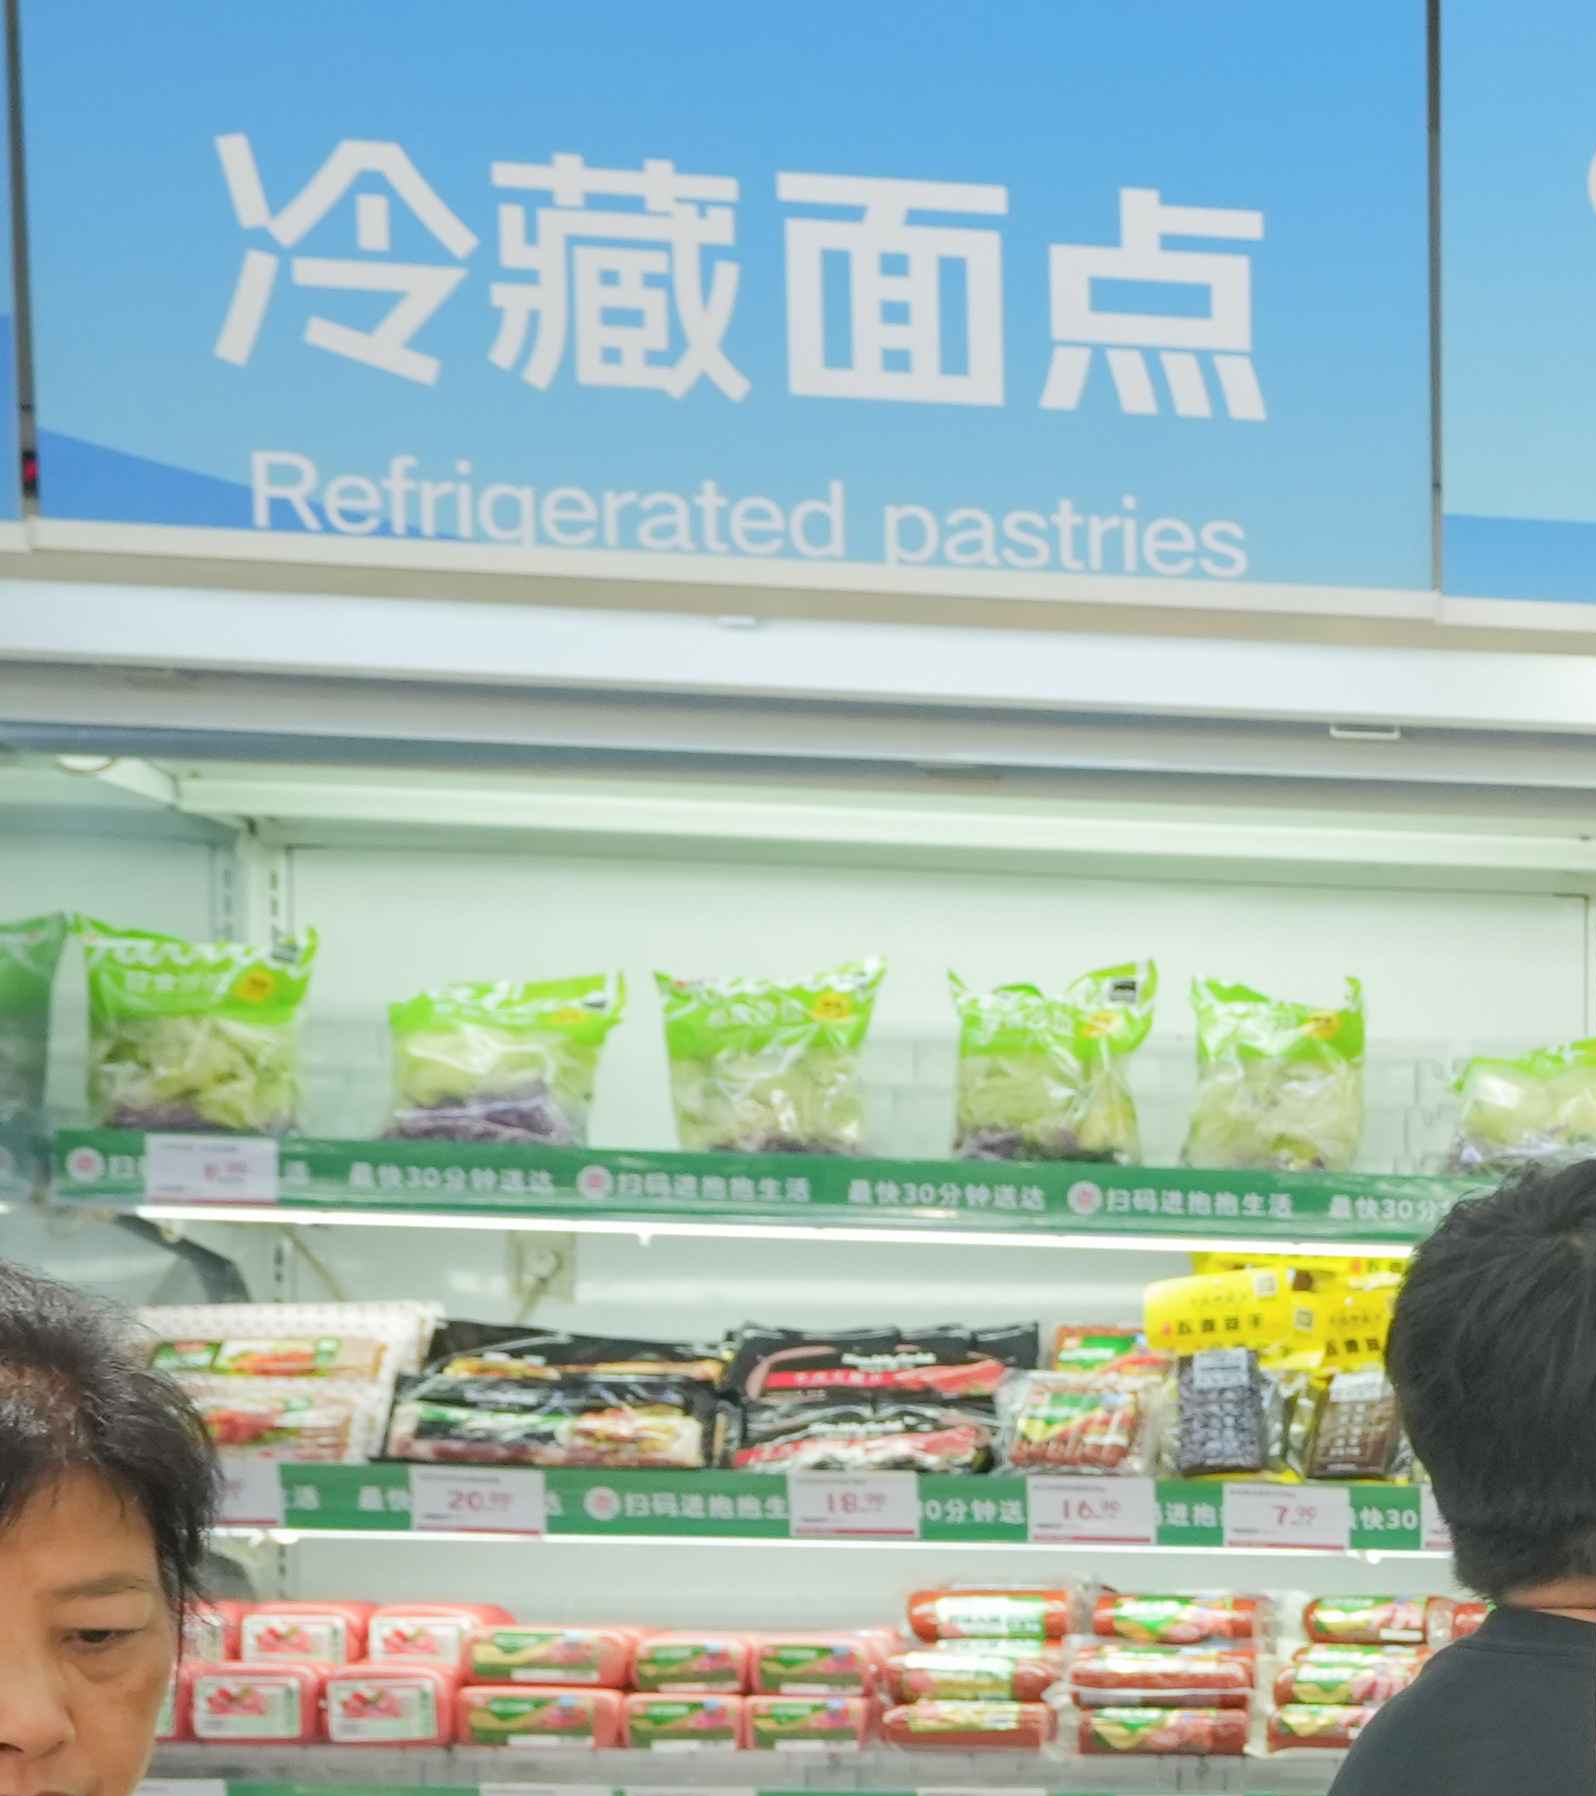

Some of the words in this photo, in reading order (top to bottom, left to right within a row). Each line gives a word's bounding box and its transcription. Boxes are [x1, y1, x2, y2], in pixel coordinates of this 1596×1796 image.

[215, 134, 1267, 421] 冷藏面点
[250, 450, 847, 552] Refrigerated
[883, 494, 1248, 577] pastries
[848, 1178, 1046, 1211] 最快30分钟送达
[1106, 1187, 1293, 1217] 扫码进抱抱生活
[1328, 1193, 1445, 1223] 最快30分
[1350, 1506, 1418, 1532] 快30
